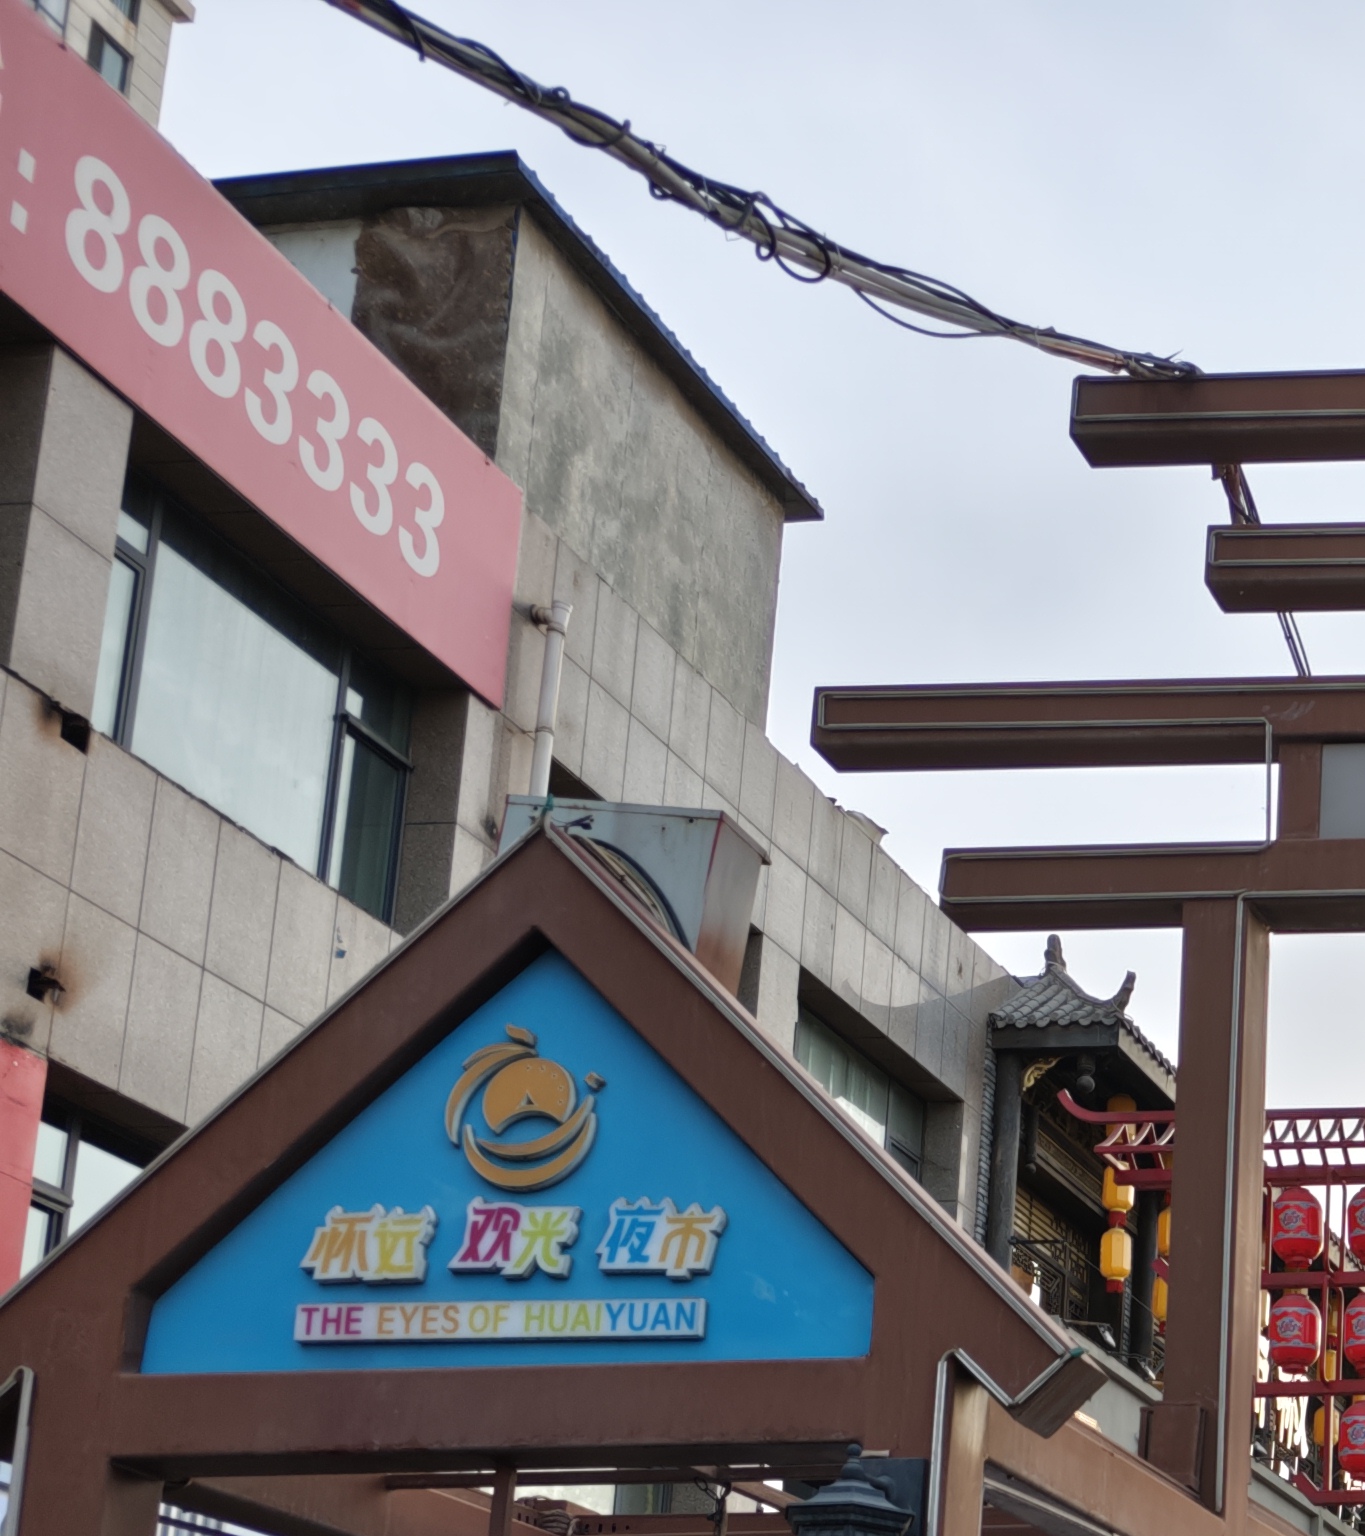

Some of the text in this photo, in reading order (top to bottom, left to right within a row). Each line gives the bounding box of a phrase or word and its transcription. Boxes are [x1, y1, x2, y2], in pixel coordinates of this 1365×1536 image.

[301, 1302, 697, 1335] THE EYES OF HUAIYUAN
